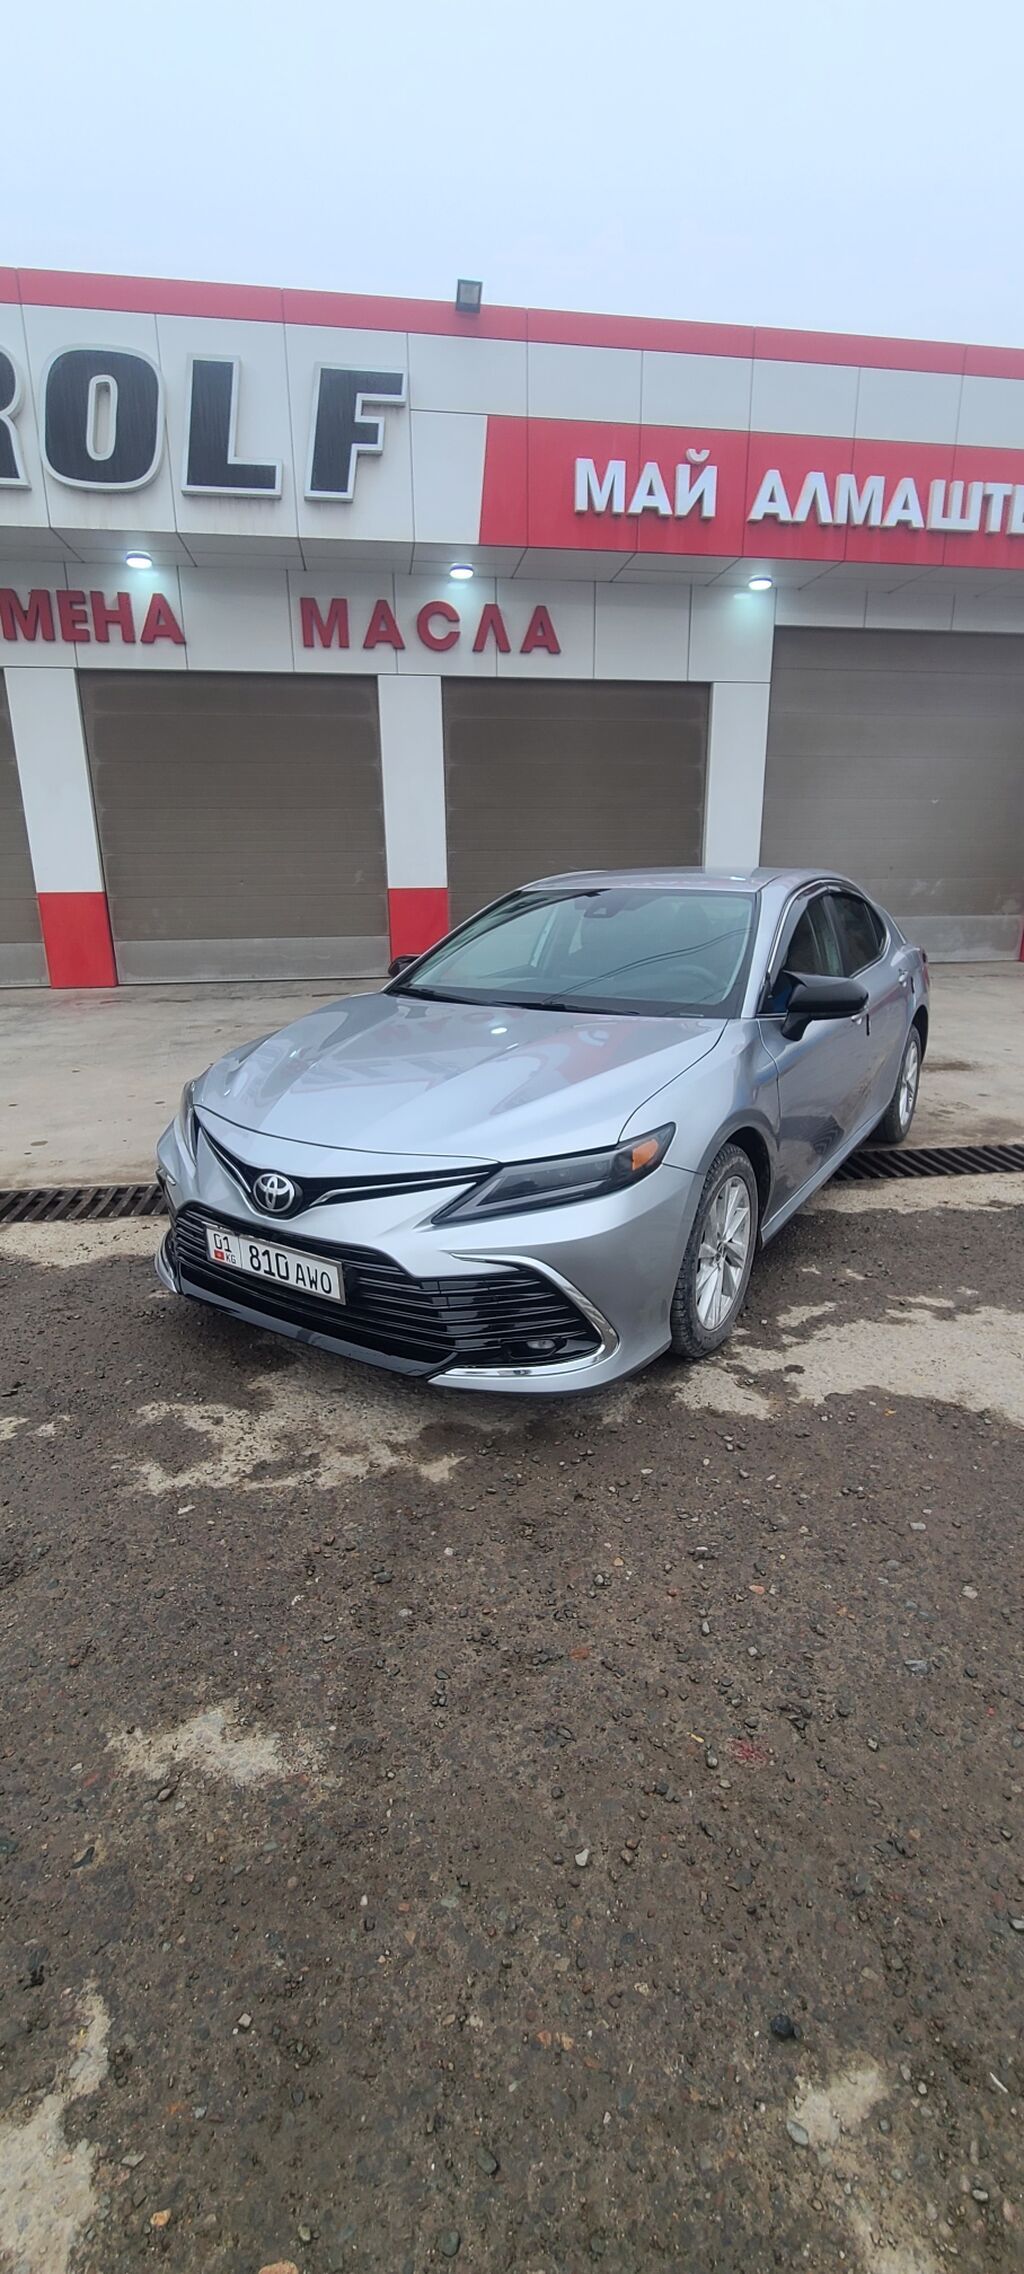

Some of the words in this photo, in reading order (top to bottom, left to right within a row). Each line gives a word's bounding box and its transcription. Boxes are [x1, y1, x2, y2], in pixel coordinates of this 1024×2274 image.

[0, 343, 407, 503] OLF
[574, 448, 718, 520] МАЙ
[0, 588, 187, 645] МЕНА
[300, 597, 562, 655] МАСЛА
[213, 1233, 232, 1253] 01
[225, 1252, 237, 1265] KG
